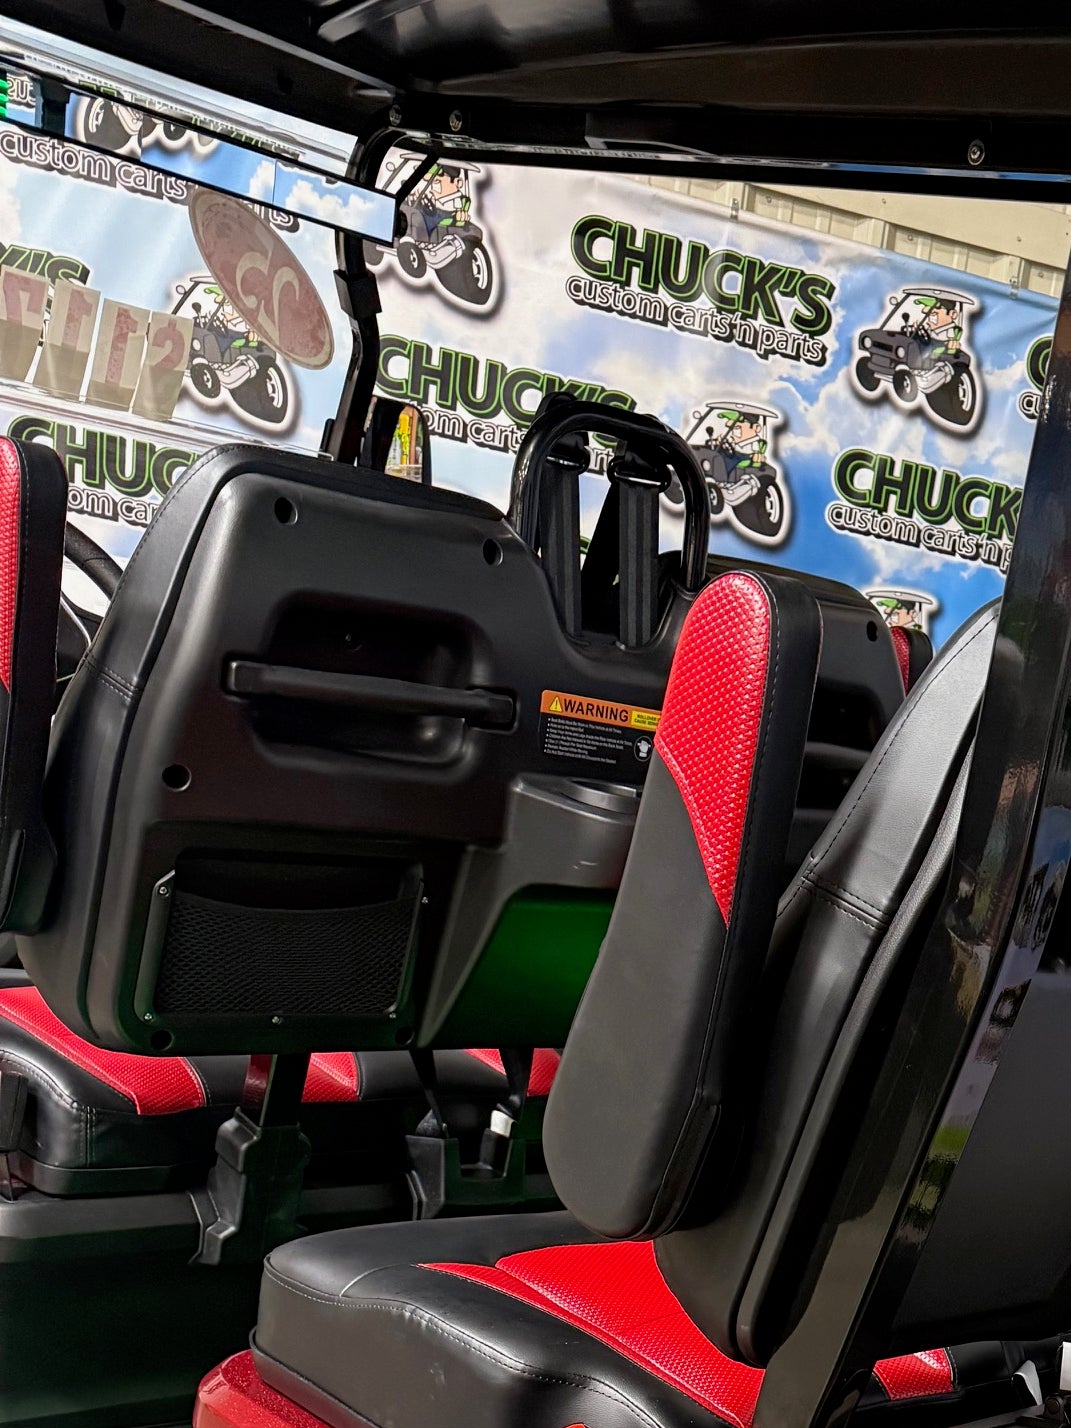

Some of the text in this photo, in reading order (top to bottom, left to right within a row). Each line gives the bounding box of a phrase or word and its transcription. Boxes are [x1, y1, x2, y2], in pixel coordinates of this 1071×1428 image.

[0, 130, 117, 188] custom
[571, 215, 836, 336] CHUCK'S
[566, 276, 669, 328] custom
[755, 325, 828, 367] parts
[828, 503, 921, 549] custom
[834, 449, 1023, 540] CHUCK
[563, 698, 629, 723] WARNING
